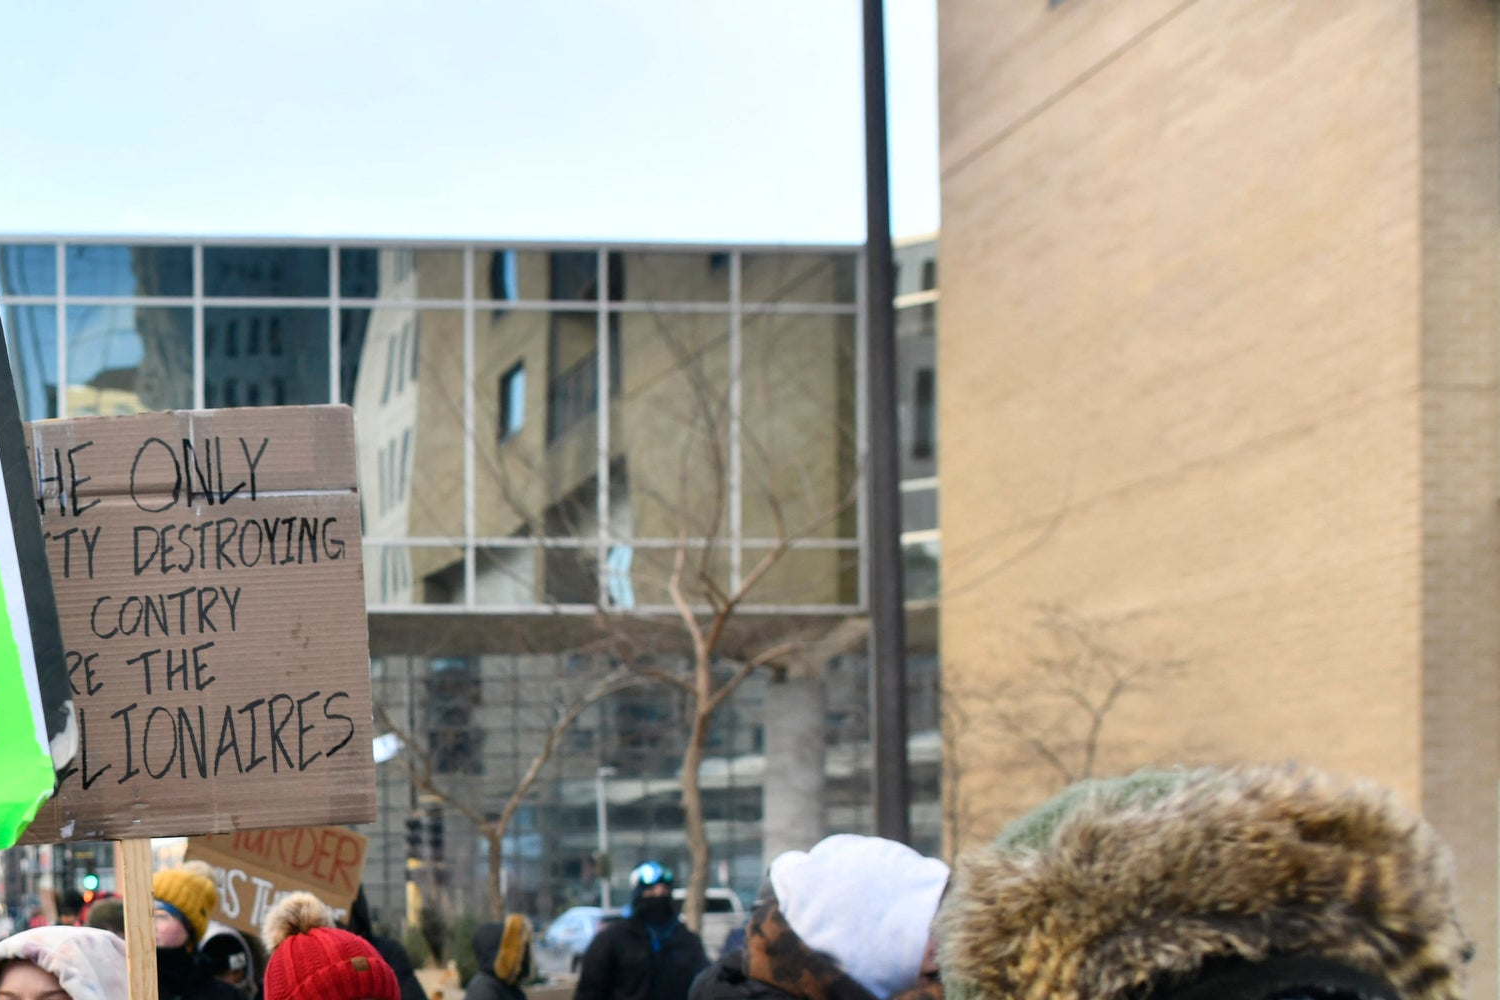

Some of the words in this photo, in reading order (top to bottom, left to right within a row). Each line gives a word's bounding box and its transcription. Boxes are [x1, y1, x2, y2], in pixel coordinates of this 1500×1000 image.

[37, 440, 101, 517] HE
[129, 436, 269, 513] ONLY
[133, 516, 346, 576] DESTROYING
[90, 585, 242, 640] CONTRY
[64, 652, 104, 697] RE
[126, 641, 216, 695] THE
[60, 691, 355, 791] LIONAIRES
[206, 827, 361, 893] URDER
